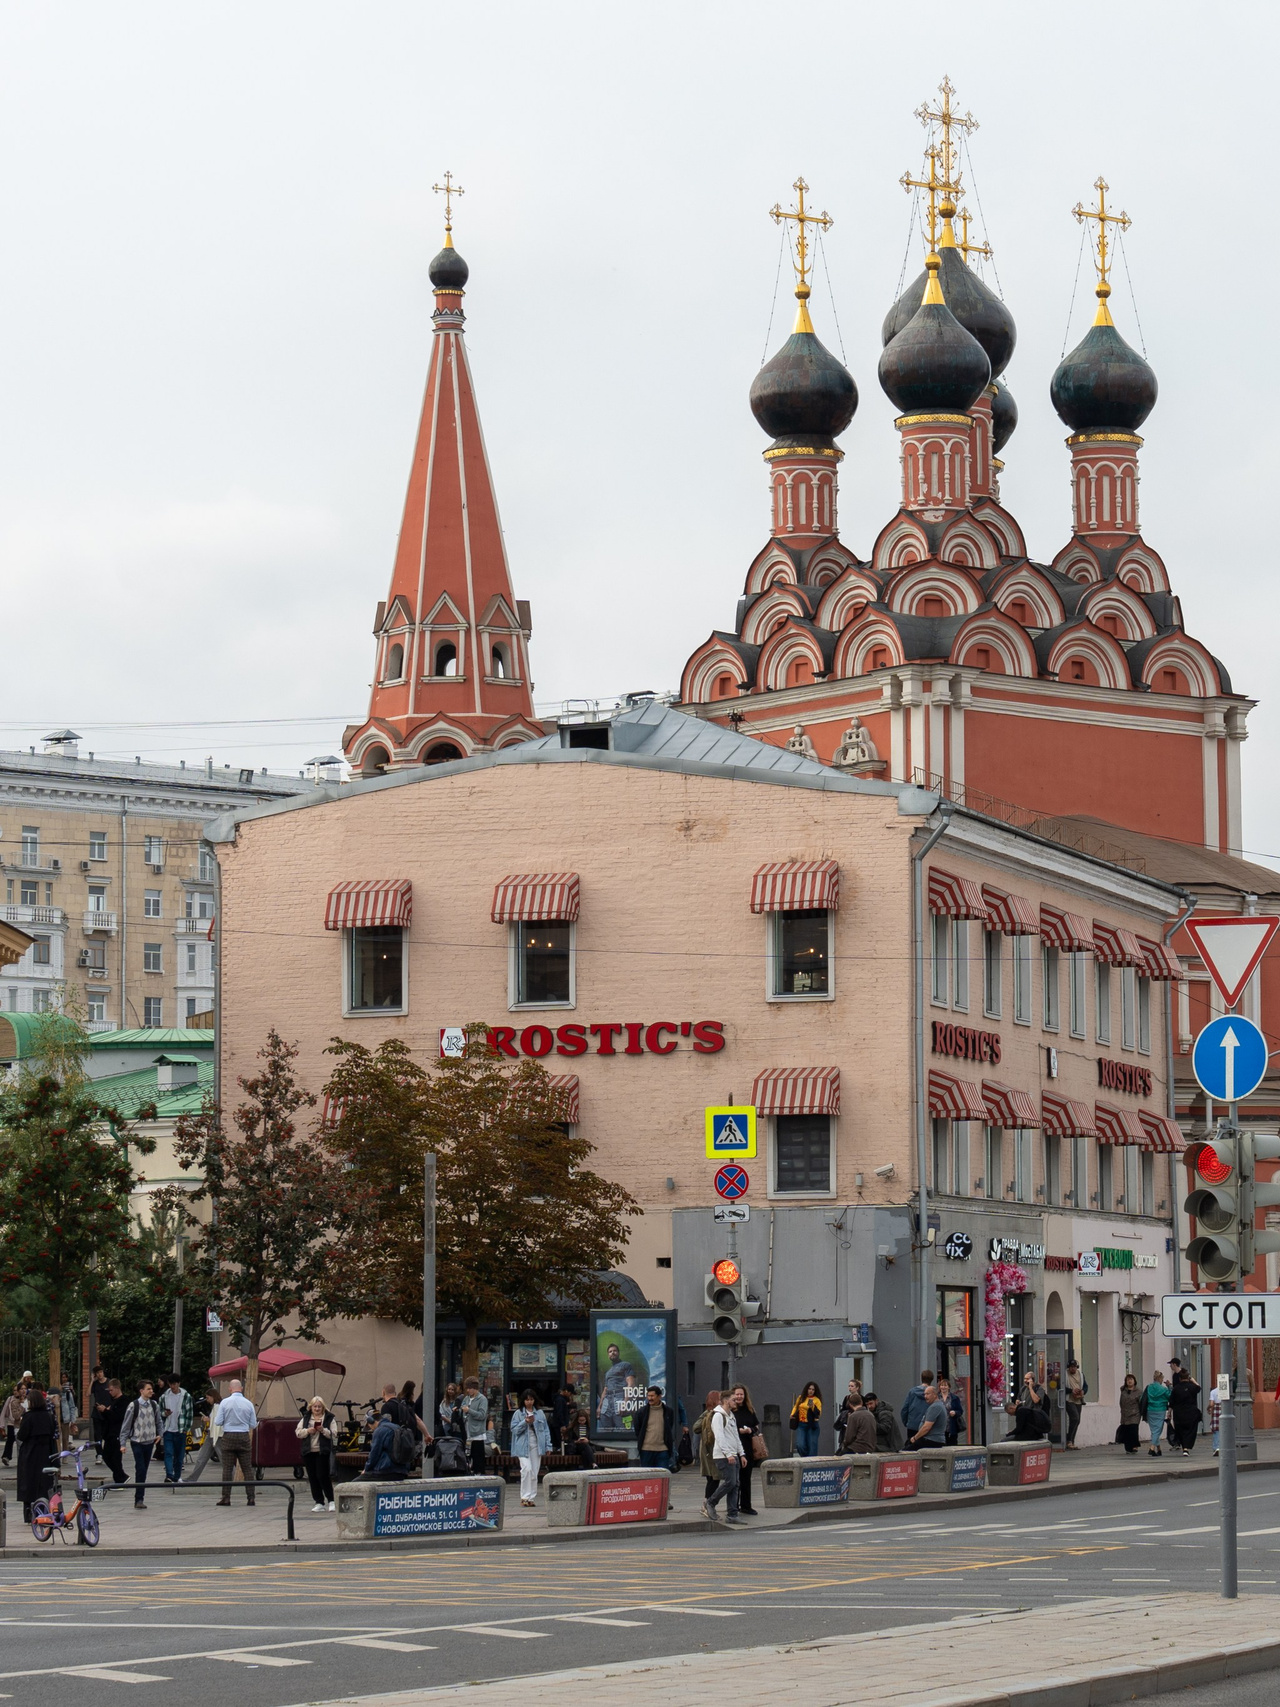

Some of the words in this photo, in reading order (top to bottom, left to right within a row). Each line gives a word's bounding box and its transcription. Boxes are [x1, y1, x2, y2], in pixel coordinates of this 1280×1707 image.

[485, 1020, 726, 1058] ROSTIC'S
[932, 1020, 1001, 1065] ROSTIC'S
[1098, 1057, 1153, 1097] ROSTIC'S
[945, 1243, 964, 1257] fix
[1045, 1254, 1075, 1271] ROSTIC'S
[1178, 1301, 1266, 1329] СТОП
[654, 1325, 662, 1333] S7
[623, 1384, 644, 1398] ТВОЁ
[616, 1399, 638, 1412] ТВОЙ
[378, 1494, 422, 1510] РЫБНЫЕ
[423, 1492, 458, 1507] РЫНКИ
[382, 1513, 394, 1523] УЛ.
[448, 1511, 454, 1519] С
[381, 1523, 442, 1534] НОВОУХТОМСКОЕ
[467, 1520, 477, 1528] 2А
